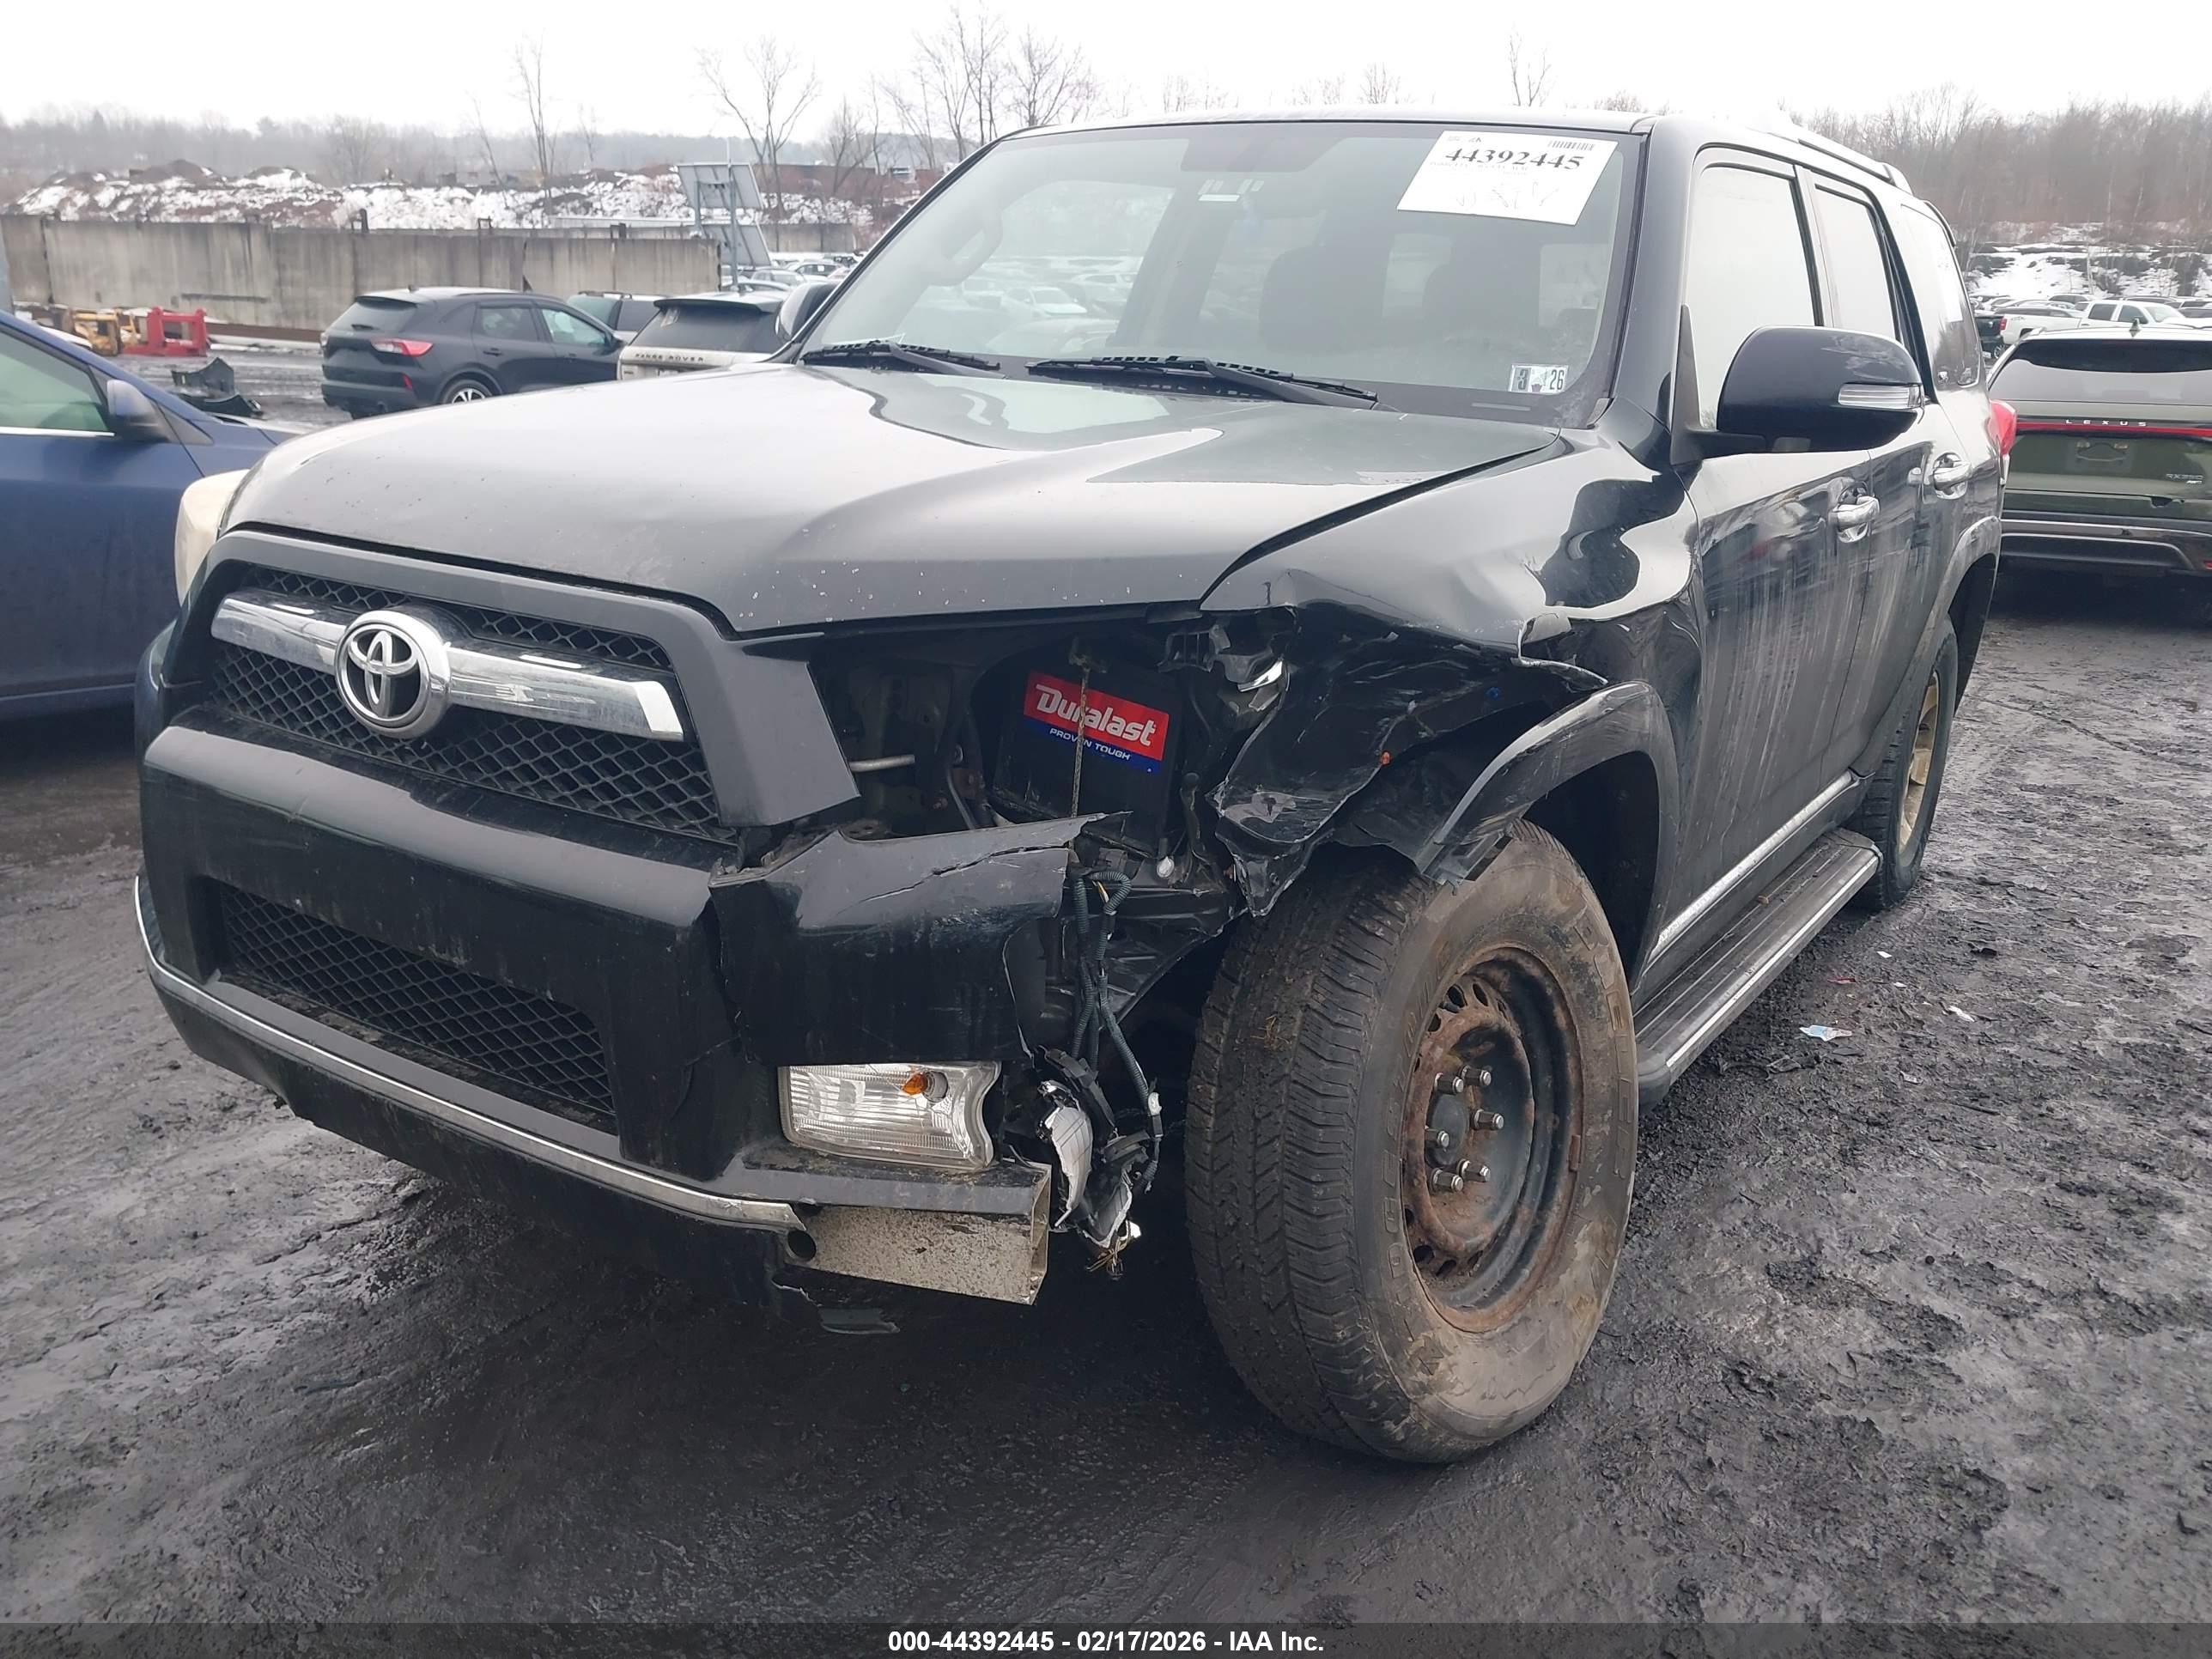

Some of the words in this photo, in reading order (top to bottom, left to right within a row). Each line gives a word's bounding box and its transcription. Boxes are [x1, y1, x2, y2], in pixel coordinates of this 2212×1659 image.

[1445, 148, 1584, 170] 44392445
[1549, 368, 1565, 390] 26
[1036, 684, 1157, 747] Duralast
[1049, 727, 1092, 748] PROVN
[1095, 742, 1131, 761] TOUGH
